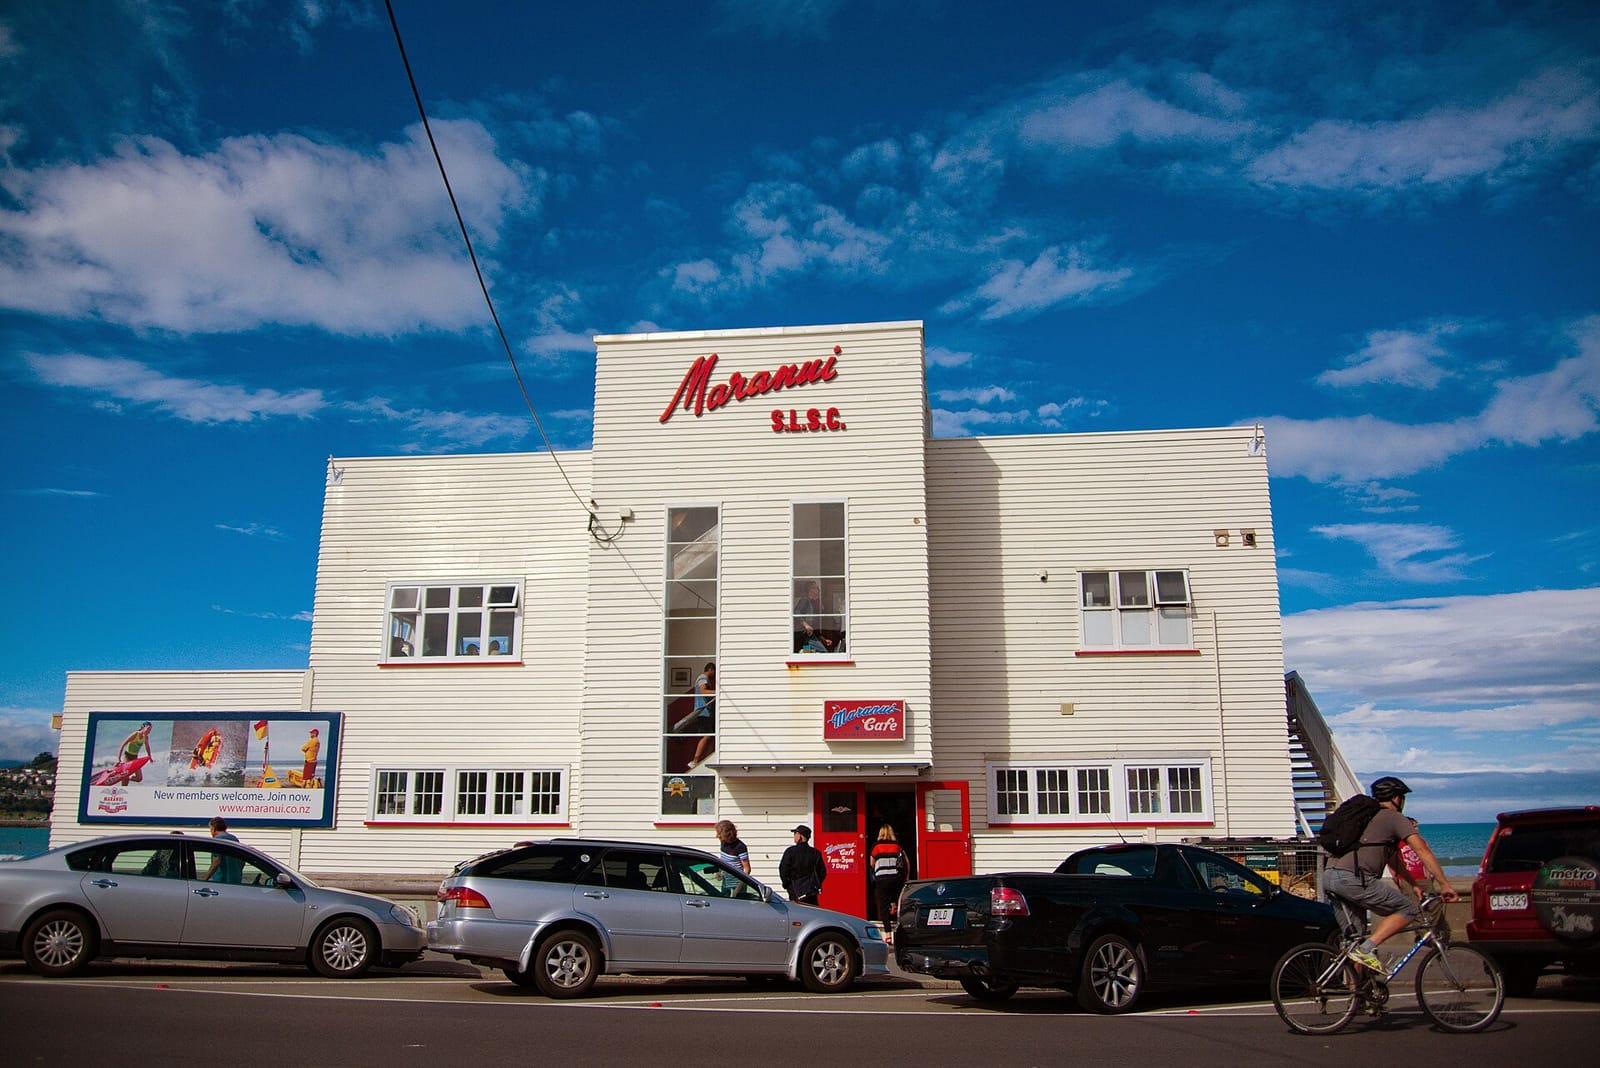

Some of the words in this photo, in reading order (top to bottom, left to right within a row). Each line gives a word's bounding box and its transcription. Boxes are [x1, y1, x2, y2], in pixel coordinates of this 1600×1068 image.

[659, 346, 842, 424] Maranui
[771, 407, 847, 433] S.L.S.C.
[827, 703, 901, 729] Maranui
[153, 790, 174, 800] New
[176, 790, 219, 801] members
[222, 791, 265, 801] welcome.
[267, 791, 287, 802] Join
[288, 794, 311, 802] now.
[218, 803, 311, 814] www.maranui.co.nz
[1549, 867, 1597, 881] metro
[1490, 894, 1527, 907] CLS329
